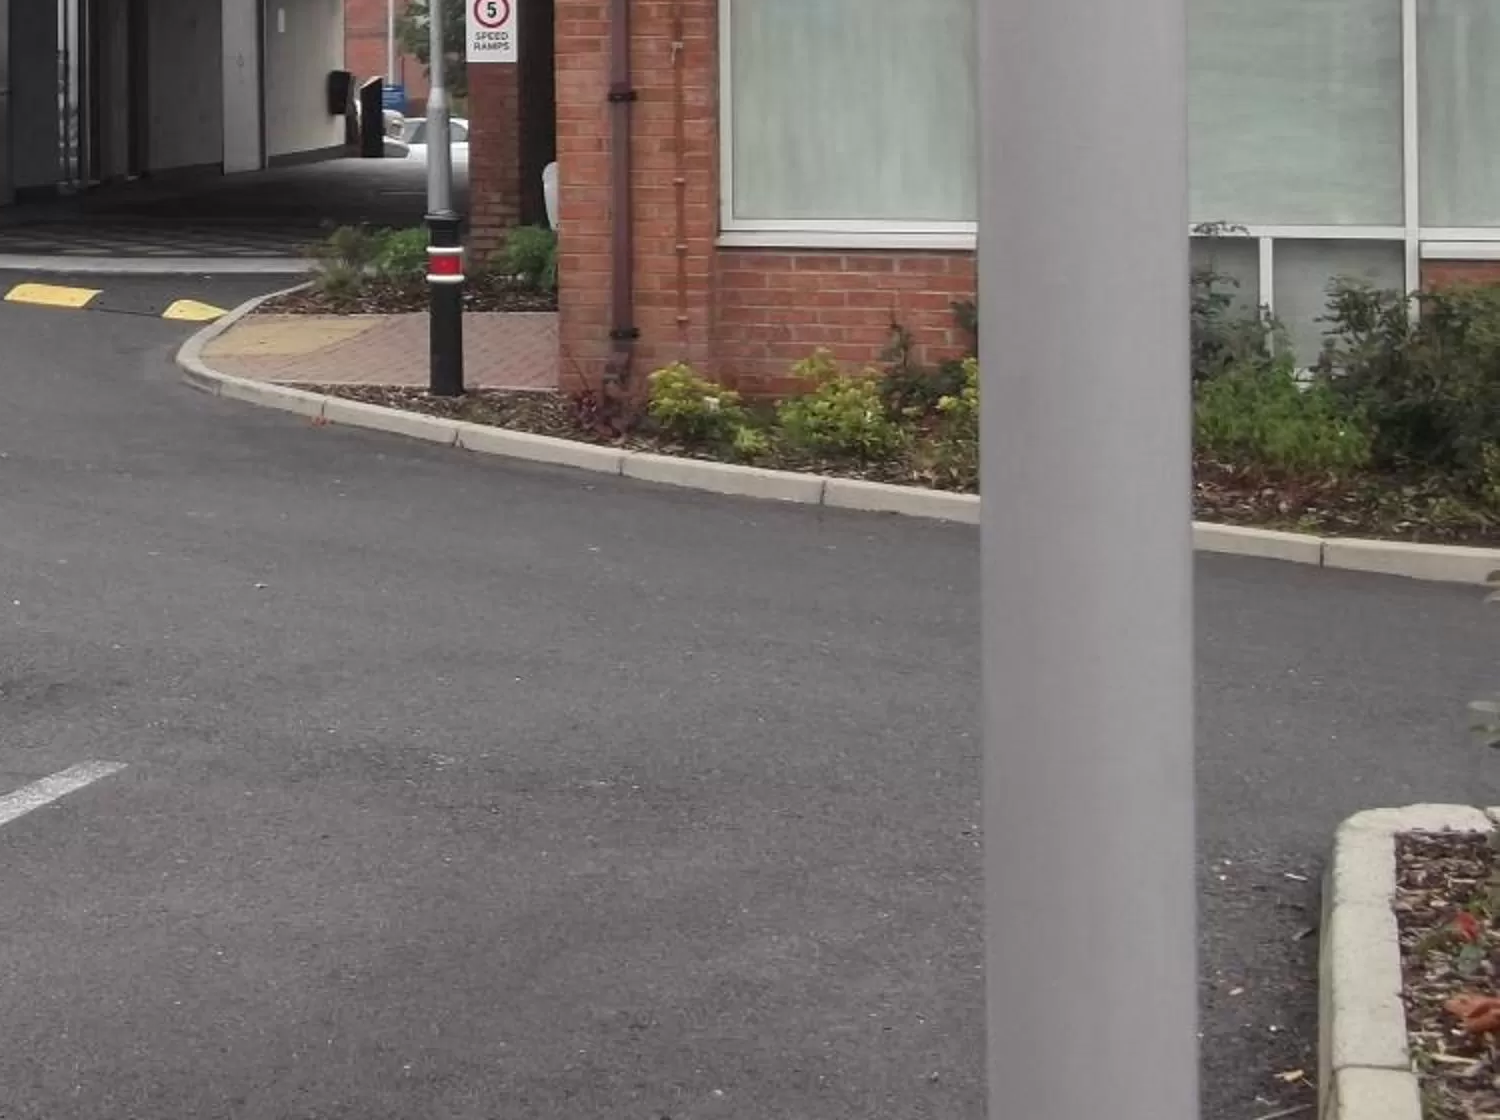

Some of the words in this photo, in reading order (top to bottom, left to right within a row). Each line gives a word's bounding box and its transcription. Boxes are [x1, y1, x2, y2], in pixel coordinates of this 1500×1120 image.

[486, 1, 498, 19] 5
[475, 31, 509, 41] SPEED
[474, 41, 510, 51] RAMPS
